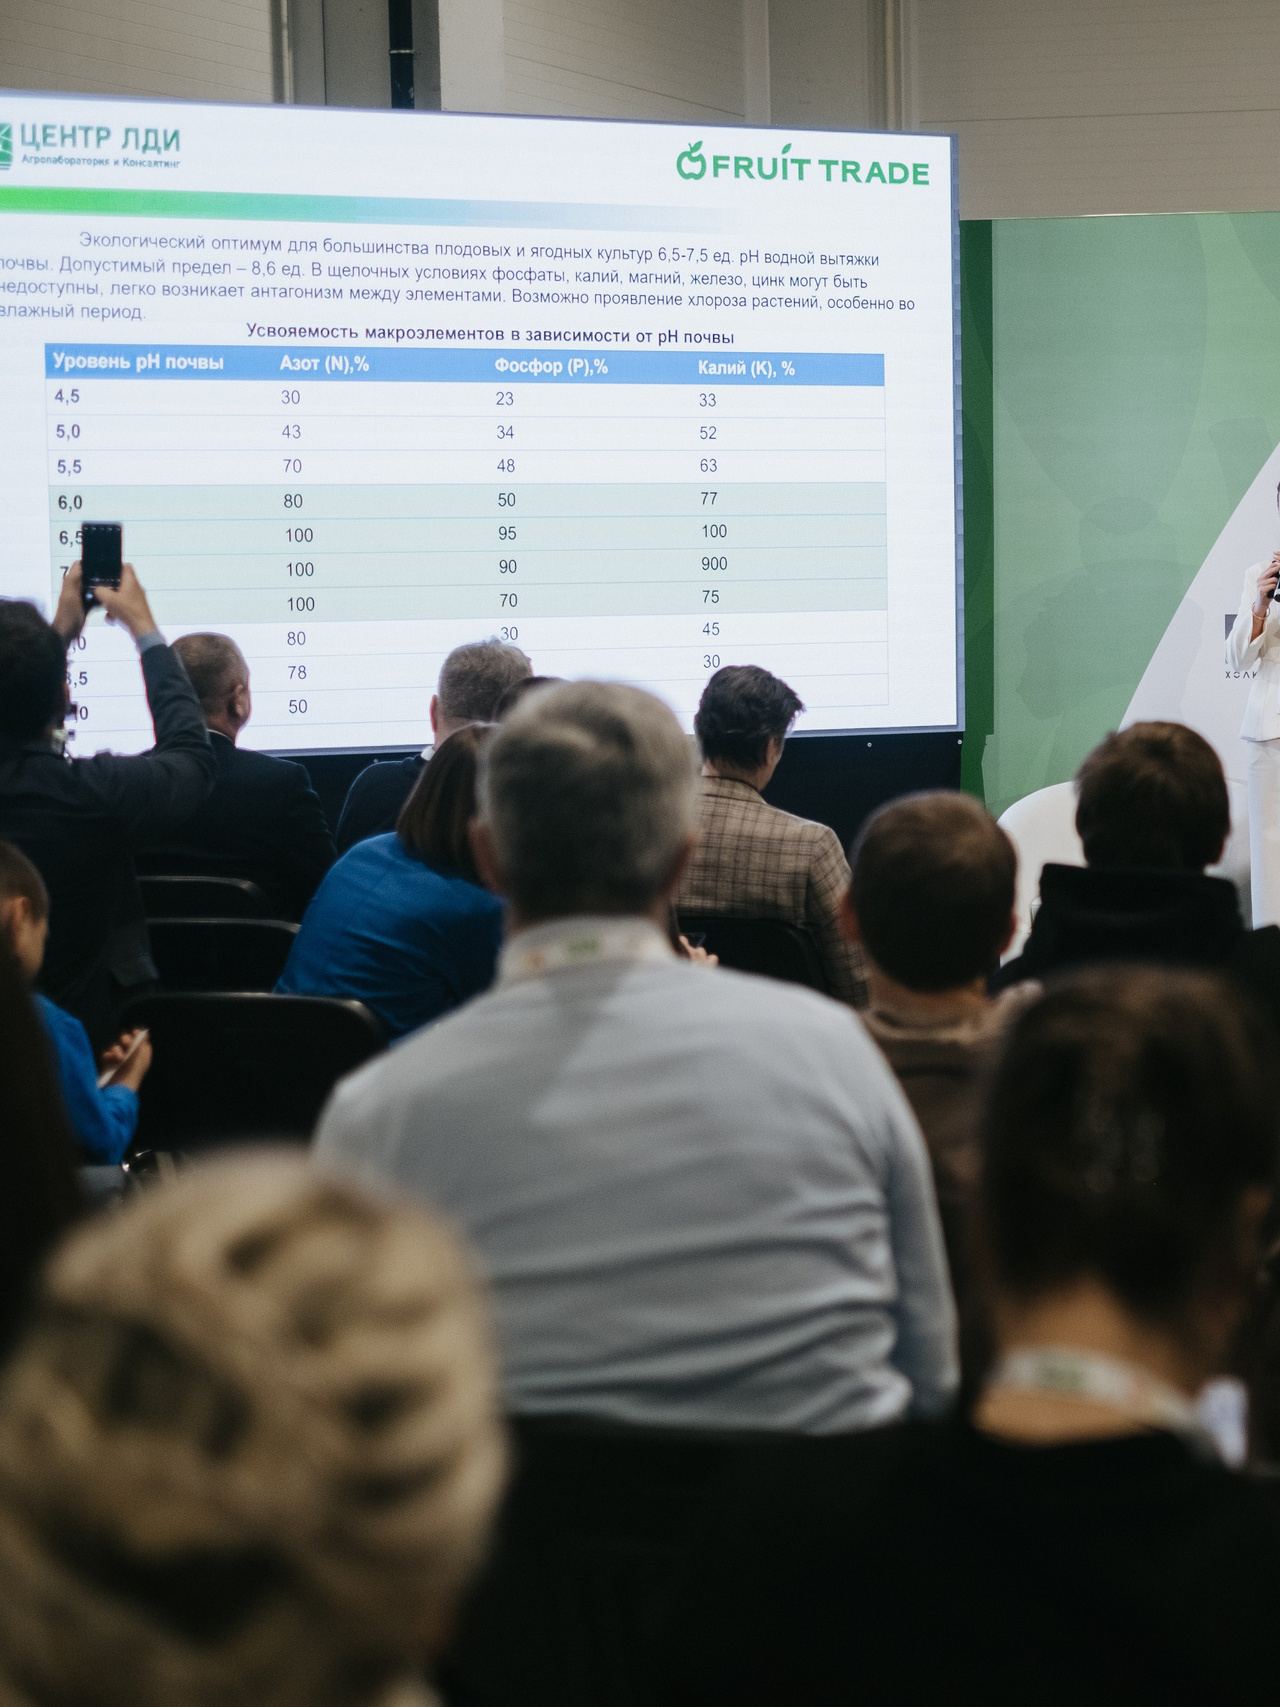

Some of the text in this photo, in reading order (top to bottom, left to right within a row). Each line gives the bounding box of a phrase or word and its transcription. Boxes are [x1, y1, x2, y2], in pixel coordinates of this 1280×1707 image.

[21, 124, 179, 154] ЦЕНТР ЛДИ
[22, 154, 109, 167] Агролаборатория
[123, 158, 180, 168] Консалтинг
[712, 152, 930, 186] FRUIT TRADE
[80, 232, 204, 248] Экологический
[212, 239, 281, 254] оптимум
[288, 241, 317, 253] для
[323, 238, 428, 254] большинства
[436, 245, 511, 258] плодовых
[517, 247, 524, 256] и
[531, 247, 592, 260] ягодных
[598, 249, 652, 264] культур
[659, 247, 708, 263] 6,5-7,5
[713, 252, 735, 264] ед.
[765, 252, 814, 266] водной
[821, 255, 878, 265] вытяжки
[60, 256, 165, 275] Допустимый
[173, 262, 231, 277] предел
[252, 261, 275, 276] 8,6
[282, 265, 304, 278] ед.
[312, 262, 322, 276] В
[328, 266, 409, 279] щелочных
[415, 268, 486, 282] условиях
[493, 266, 569, 284] фосфаты,
[576, 270, 622, 284] калий,
[629, 271, 684, 286] магний,
[691, 275, 746, 287] железо,
[753, 276, 784, 288] цинк
[790, 277, 828, 291] могут
[834, 274, 867, 288] быть
[111, 284, 156, 295] легко
[162, 285, 244, 297] возникает
[251, 287, 342, 299] антагонизм
[350, 289, 400, 304] между
[406, 290, 506, 301] элементами.
[513, 289, 588, 303] Возможно
[595, 294, 682, 307] проявление
[688, 296, 746, 309] хлороза
[753, 296, 822, 310] растений,
[828, 296, 894, 309] особенно
[899, 300, 914, 310] во
[81, 307, 146, 322] период.
[247, 323, 358, 338] Усвояемость
[366, 329, 504, 342] макроэлементов
[512, 331, 520, 340] в
[526, 331, 629, 342] зависимости
[636, 333, 652, 342] от
[685, 333, 733, 343] почвы
[53, 352, 130, 371] Уровень
[166, 357, 223, 369] почвы
[280, 355, 369, 374] Азот (N),%
[495, 358, 608, 376] Фосфор (P),%
[699, 360, 795, 378] Калий (K), %
[55, 389, 79, 405] 4,5
[282, 390, 300, 404] 30
[496, 392, 513, 405] 23
[700, 393, 716, 407] 33
[57, 424, 80, 440] 5,0
[282, 425, 301, 439] 43
[497, 425, 514, 439] 34
[700, 426, 716, 439] 52
[58, 460, 81, 476] 5,5
[284, 459, 301, 473] 70
[497, 459, 515, 472] 48
[701, 459, 717, 472] 63
[58, 495, 82, 512] 6,0
[284, 494, 302, 508] 80
[498, 493, 515, 507] 50
[701, 492, 717, 505] 77
[286, 528, 313, 542] 100
[499, 526, 516, 540] 95
[703, 524, 727, 538] 100
[287, 562, 314, 576] 100
[499, 560, 516, 573] 90
[702, 557, 727, 570] 900
[500, 593, 517, 607] 70
[703, 590, 719, 603] 75
[288, 597, 314, 611] 100
[501, 627, 518, 640] 30
[703, 622, 719, 635] 45
[287, 631, 306, 645] 80
[704, 655, 720, 668] 30
[288, 665, 306, 679] 78
[289, 699, 307, 713] 50
